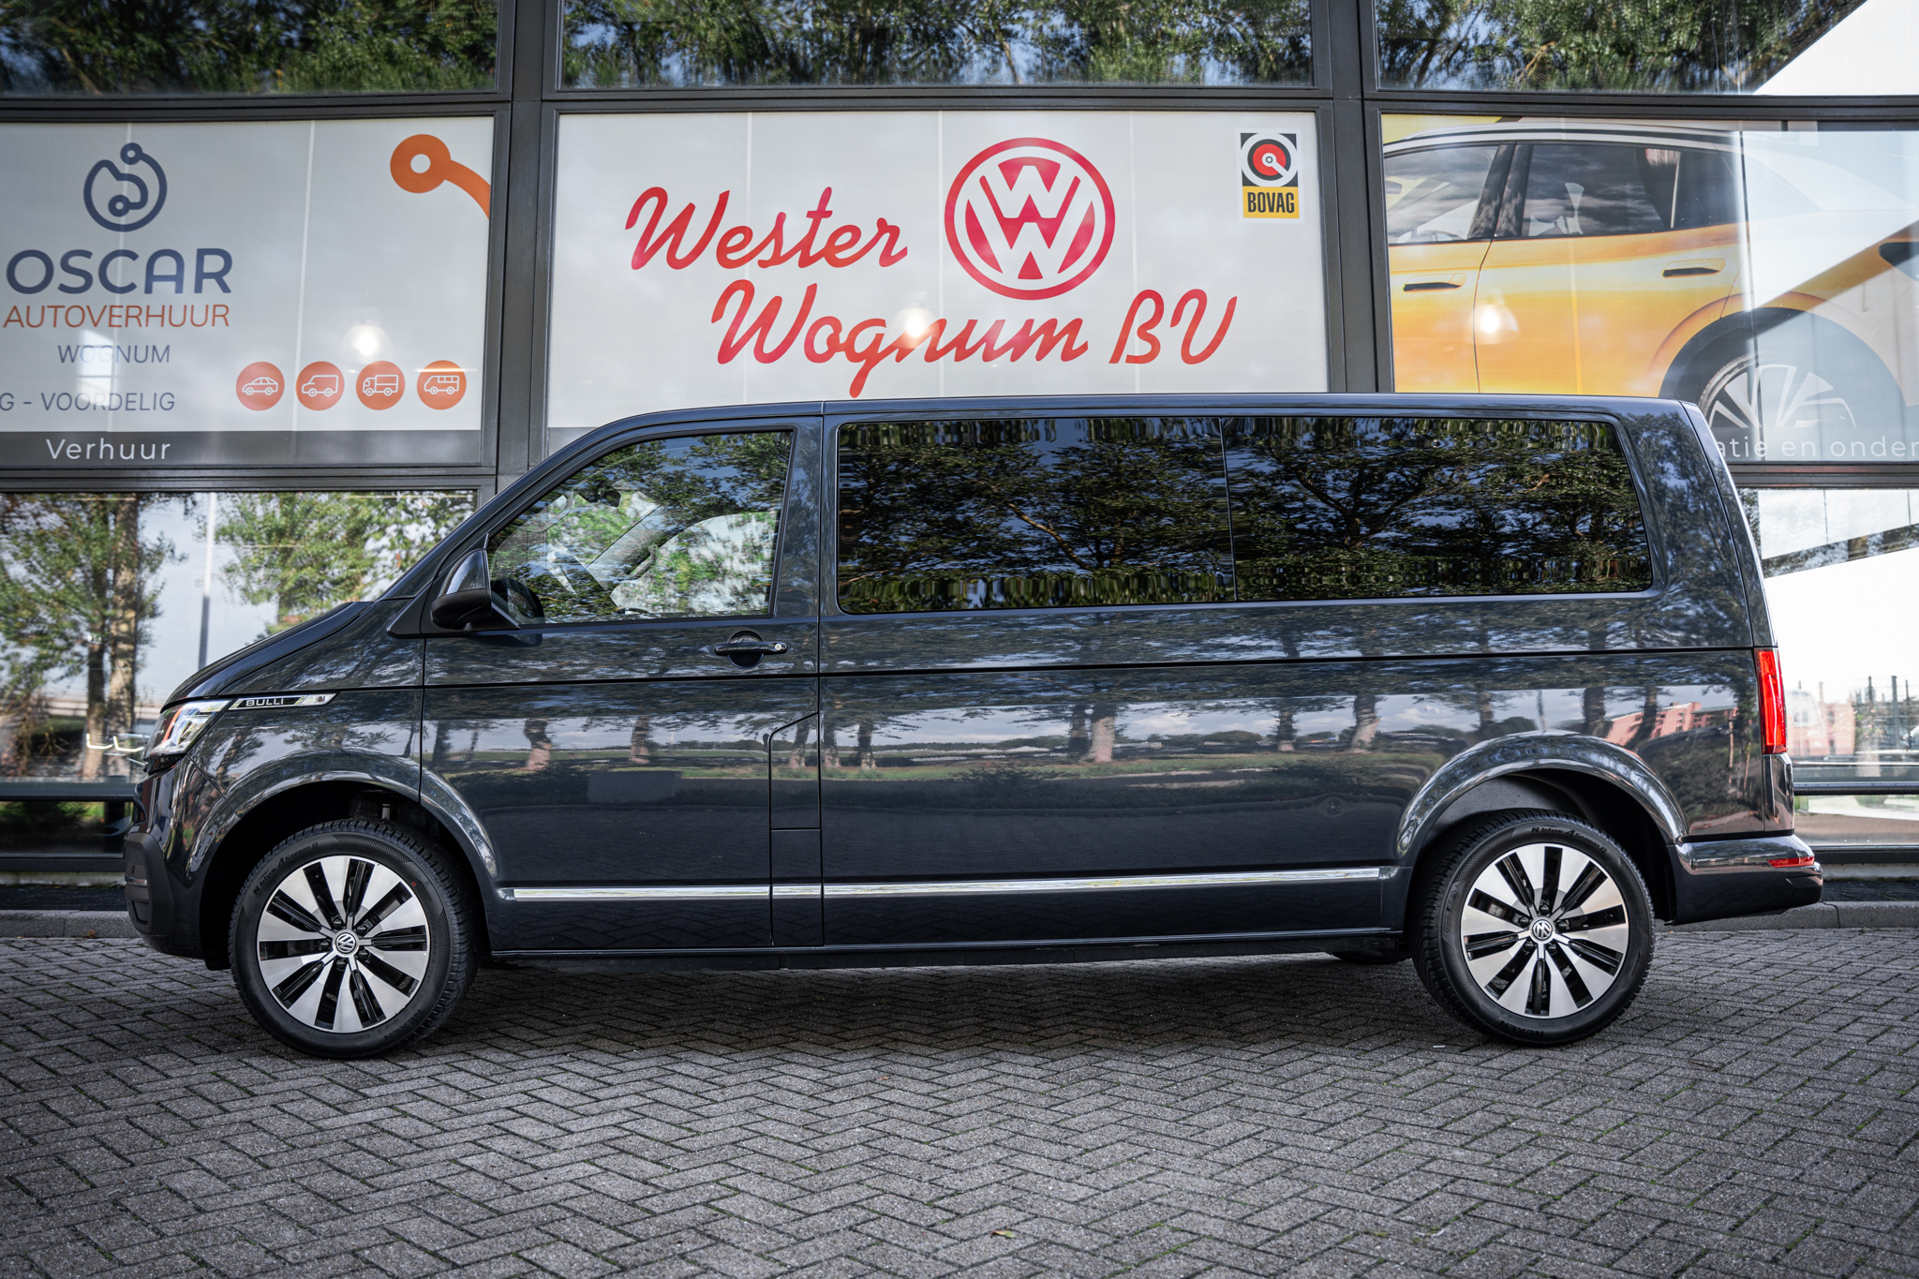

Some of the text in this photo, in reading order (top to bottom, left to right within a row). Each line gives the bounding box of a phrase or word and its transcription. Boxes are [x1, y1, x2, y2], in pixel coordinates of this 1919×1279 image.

[1247, 191, 1295, 213] BOVAG
[624, 186, 908, 270] Wester
[6, 247, 234, 295] OSCAR
[3, 304, 230, 329] AUTOVERHUUR
[711, 279, 1237, 399] Wognum BV
[57, 344, 171, 364] WOGNUM
[40, 392, 176, 412] VOORDELIG
[46, 438, 172, 460] Verhuur
[1781, 440, 1817, 457] en
[1830, 435, 1919, 457] onder
[245, 698, 284, 707] BULLI
